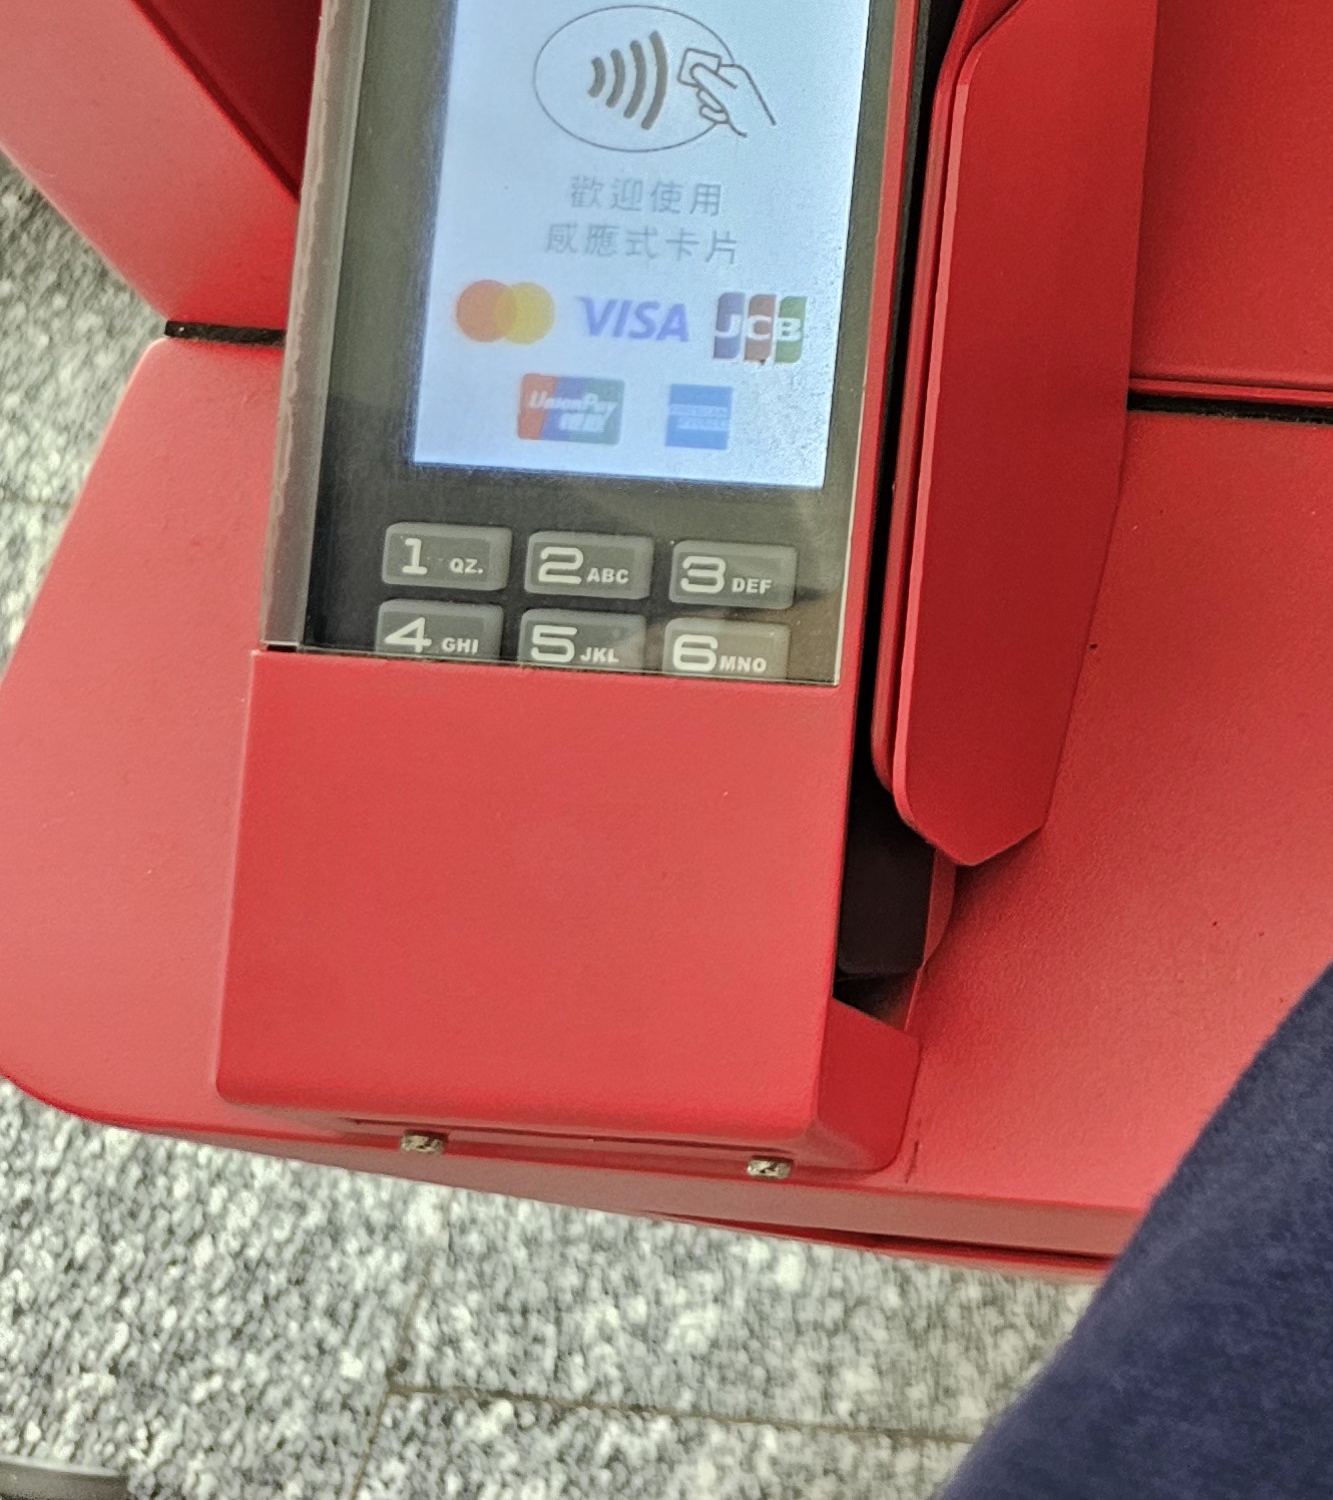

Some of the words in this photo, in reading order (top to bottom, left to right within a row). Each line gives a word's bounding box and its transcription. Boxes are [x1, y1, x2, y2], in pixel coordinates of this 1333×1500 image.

[571, 175, 722, 216] 歡迎使用
[575, 296, 689, 342] VISA
[402, 537, 428, 575] 1
[450, 557, 484, 575] QZ.
[538, 546, 584, 585] 2
[587, 567, 629, 585] ABC
[680, 555, 726, 594] 3
[731, 578, 772, 595] DEF
[384, 616, 432, 653] 4
[441, 636, 479, 655] GHI
[531, 624, 578, 663] 5
[580, 647, 620, 664] JKL
[672, 634, 718, 672] 6
[719, 655, 767, 673] MNO
